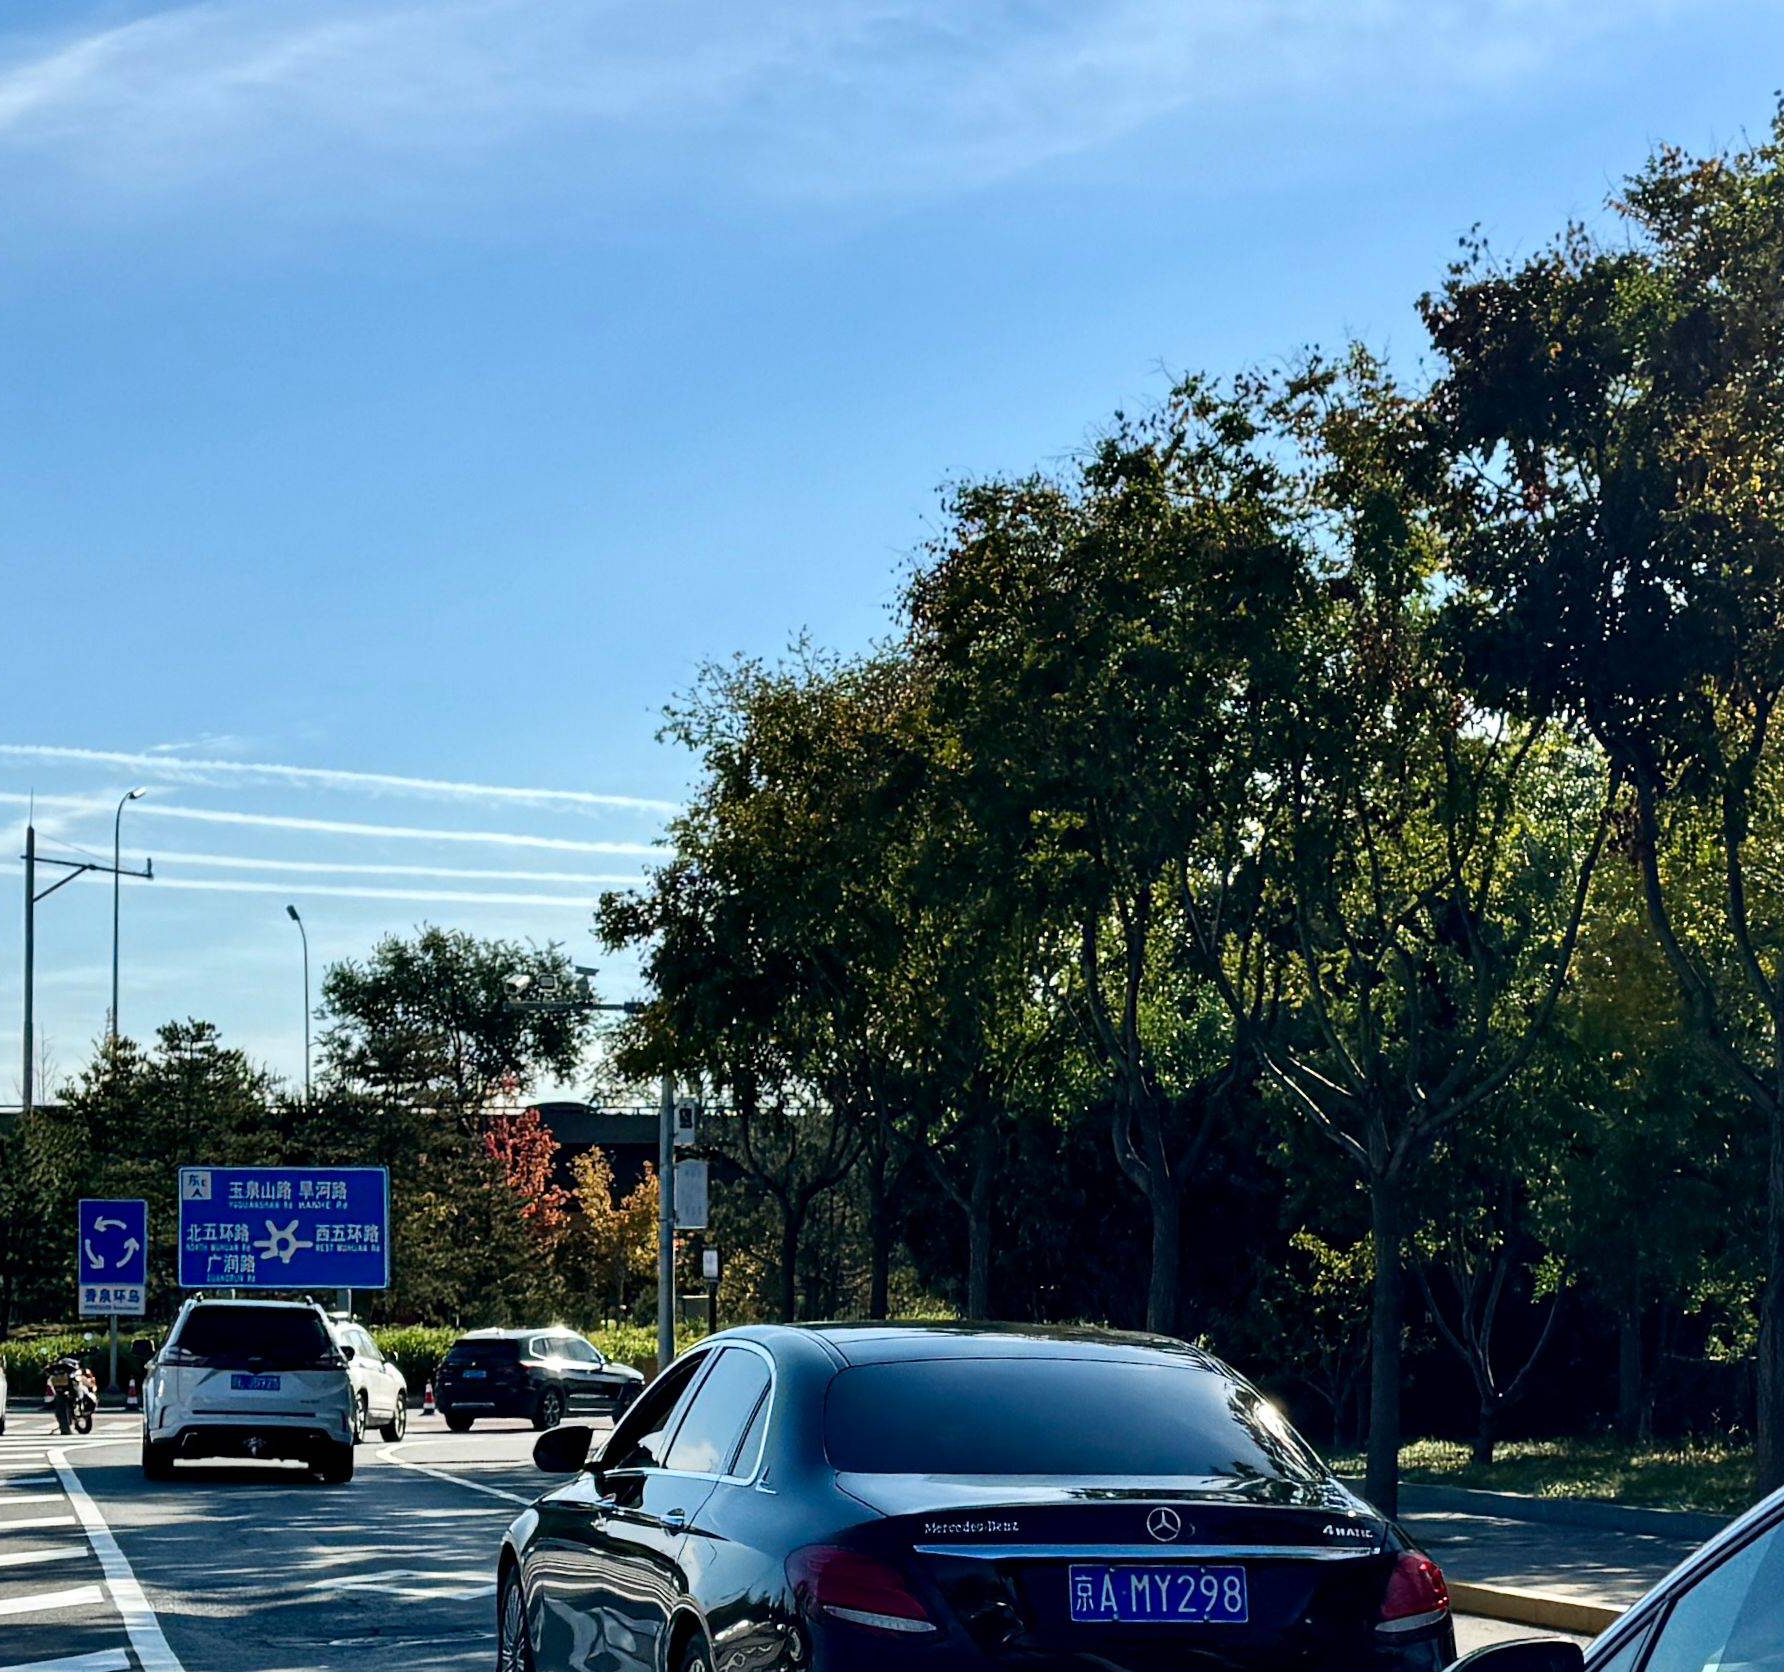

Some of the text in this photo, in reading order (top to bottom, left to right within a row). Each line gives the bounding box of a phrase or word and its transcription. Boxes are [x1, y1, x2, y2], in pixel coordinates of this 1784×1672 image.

[228, 1180, 348, 1200] 玉泉山路 旱河路
[186, 1223, 249, 1242] 北五环路
[315, 1224, 379, 1243] 西五环路
[207, 1254, 256, 1274] 广润路
